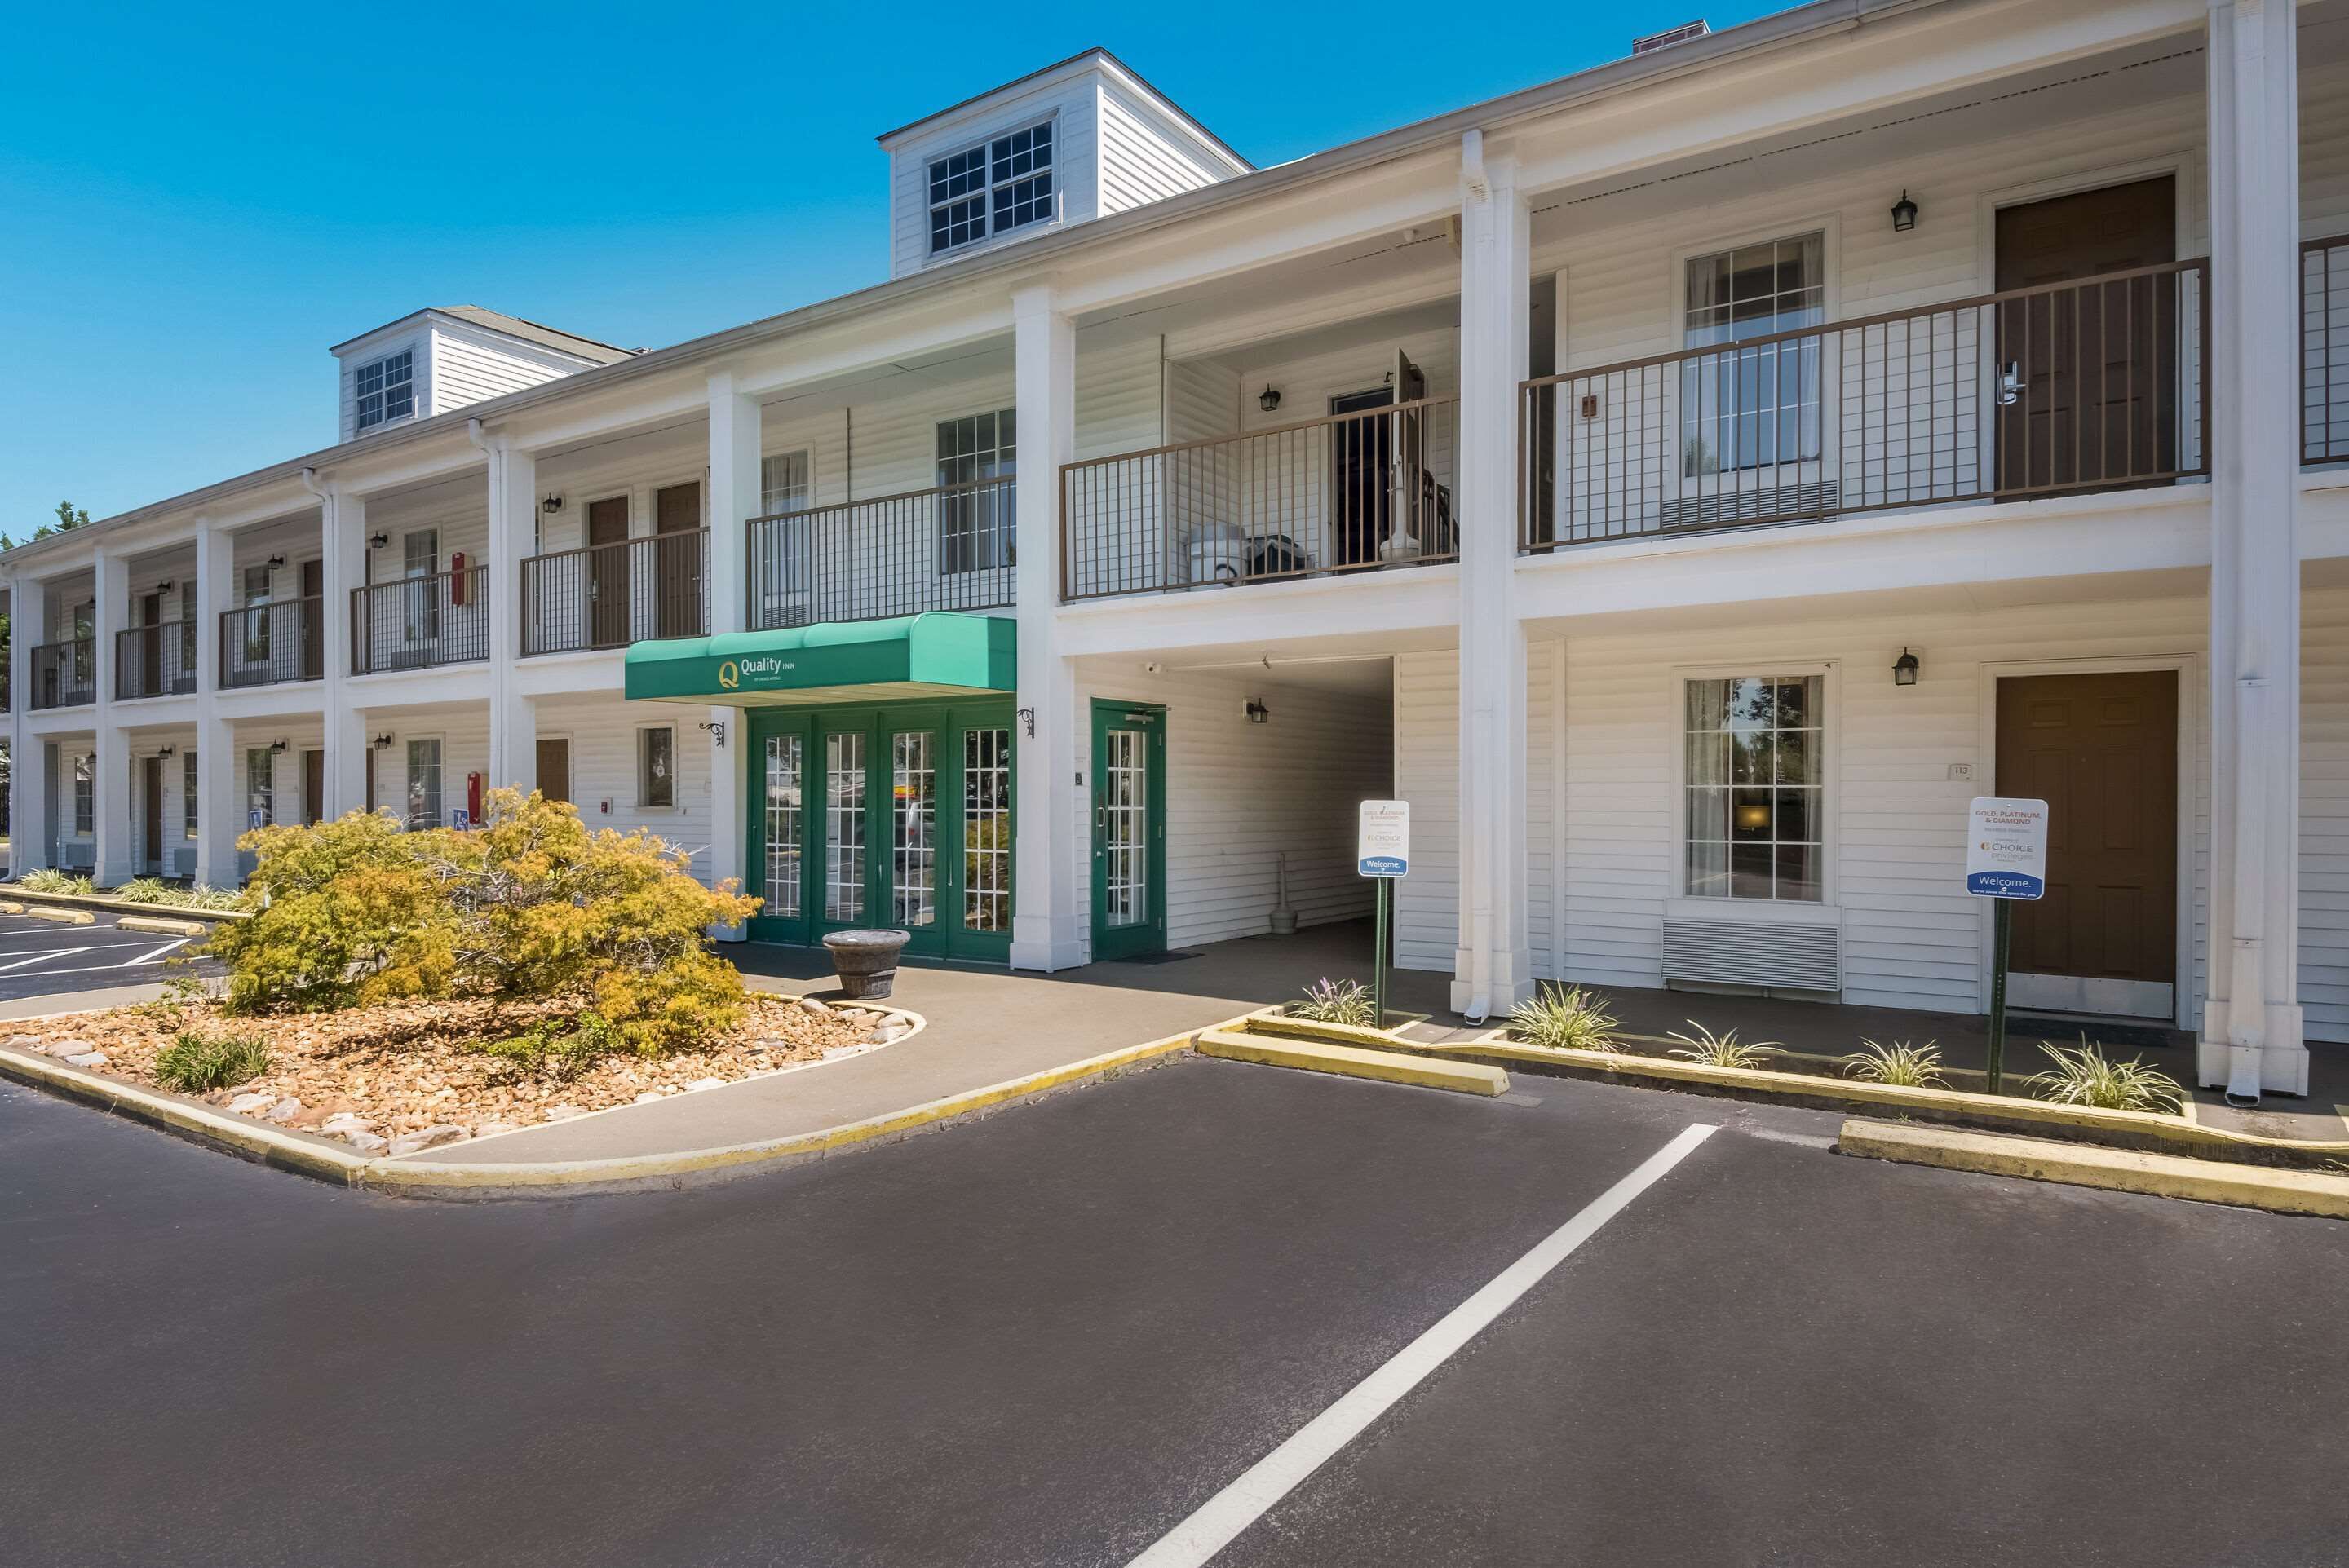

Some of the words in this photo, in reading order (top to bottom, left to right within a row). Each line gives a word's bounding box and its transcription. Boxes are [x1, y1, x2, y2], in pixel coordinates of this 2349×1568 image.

[741, 658, 781, 675] Quality
[1992, 842, 2033, 853] CHOICE
[1979, 876, 2032, 888] Welcome.
